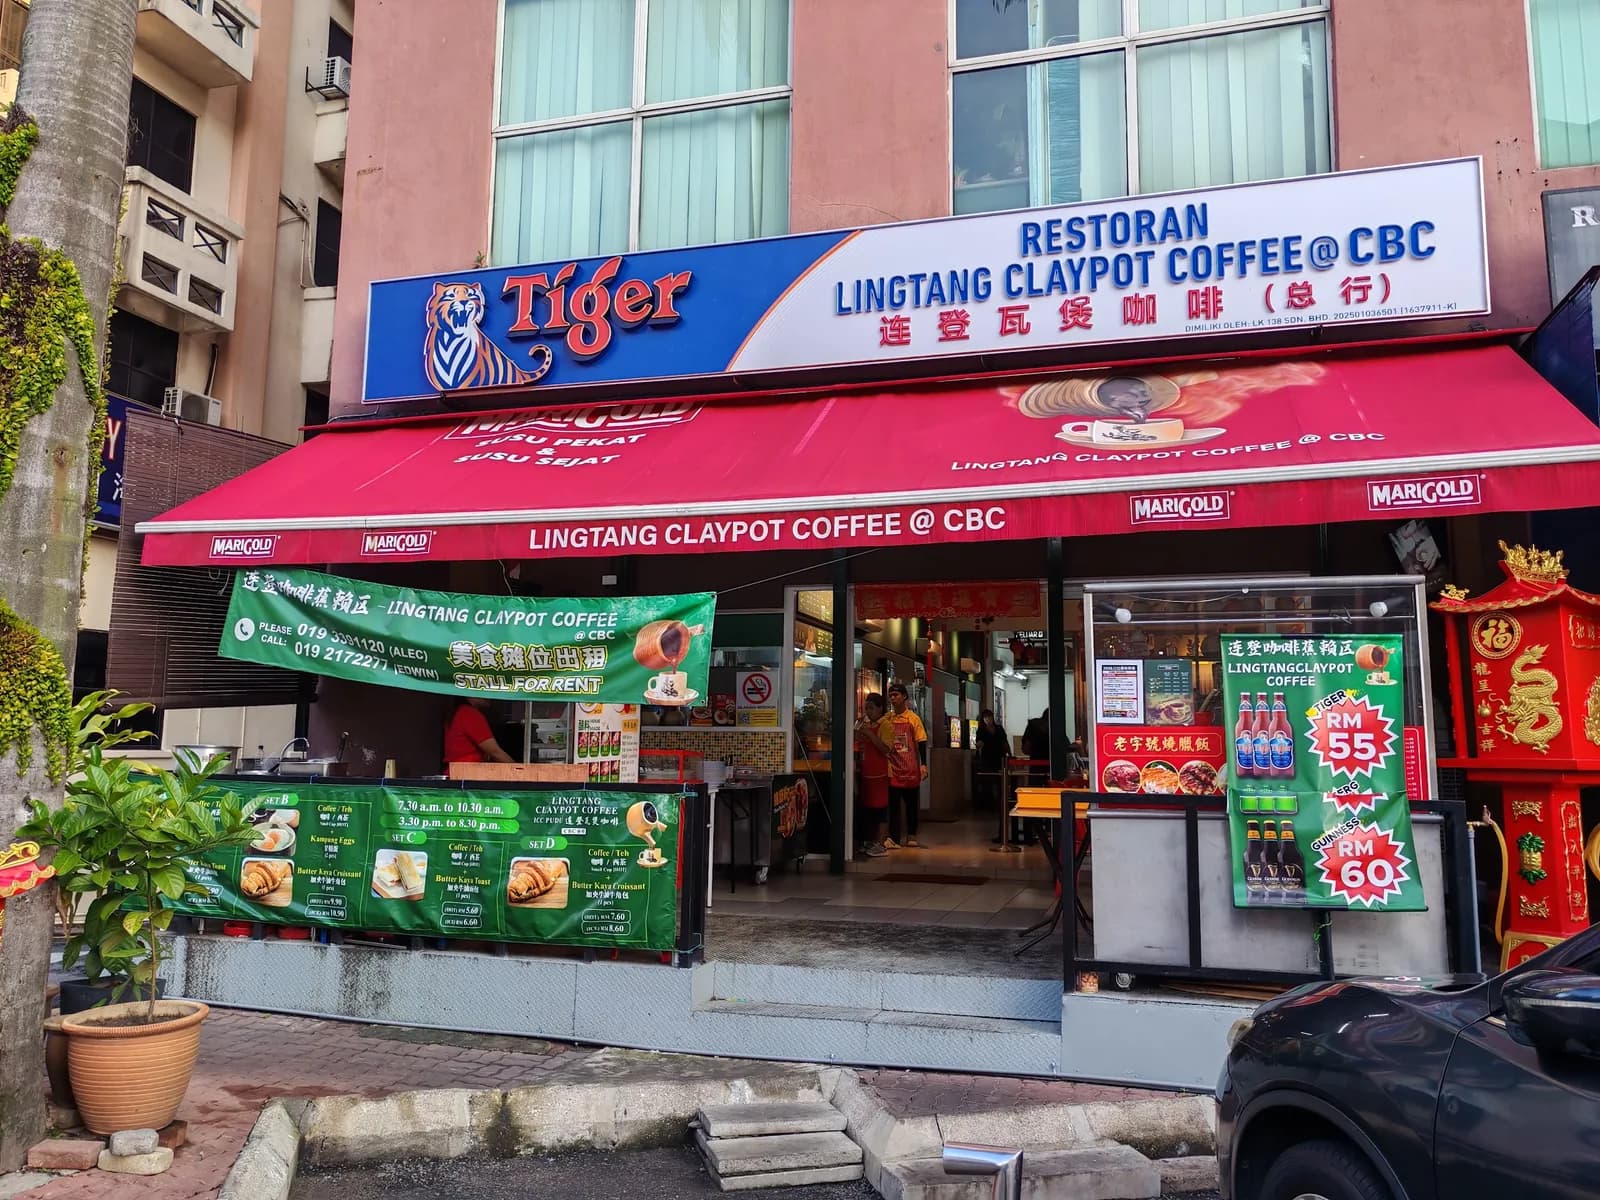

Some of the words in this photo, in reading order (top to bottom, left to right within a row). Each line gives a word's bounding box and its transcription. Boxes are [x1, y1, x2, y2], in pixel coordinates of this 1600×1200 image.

[1021, 202, 1209, 257] RESTORAN
[835, 267, 992, 315] LINGTANG
[1004, 251, 1155, 298] CLAYPOT
[502, 256, 693, 357] Tiger
[1185, 323, 1222, 333] DIMILIKI
[1252, 319, 1264, 327] LK
[1267, 317, 1282, 325] 138
[1284, 316, 1305, 324] SDN.
[1308, 314, 1331, 322] BHD.
[1333, 309, 1397, 320] 202501036501
[475, 433, 547, 447] SUSU
[553, 434, 647, 447] PEKAT
[453, 452, 530, 464] SUSU
[535, 454, 621, 467] SEJAT
[536, 447, 557, 456] &
[951, 451, 1069, 471] LINGTANG
[1075, 450, 1185, 463] CLAYPOT
[1191, 440, 1291, 457] COFFEE
[1298, 433, 1321, 445] @
[1330, 432, 1386, 441] CBC
[1372, 480, 1474, 506] MARIGOLD
[1135, 495, 1224, 520] MARIGOLD
[529, 524, 657, 549] LINGTANG
[664, 519, 785, 545] CLAYPOT
[792, 512, 902, 541] COFFEE
[909, 509, 935, 535] @
[944, 506, 1007, 532] CBC
[213, 537, 273, 556] MARIGOLD
[364, 534, 428, 553] MARIGOLD
[475, 610, 547, 627] CLAYPOT
[552, 612, 618, 628] COFFEE
[259, 622, 292, 635] PLEASE
[574, 631, 586, 641] @
[589, 630, 615, 640] CBC
[1480, 619, 1513, 649] 福
[261, 634, 287, 646] CALL:
[298, 623, 328, 640] 019
[331, 630, 385, 653] 3391120
[389, 646, 428, 663] (ALEC)
[295, 642, 320, 658] 019
[324, 647, 388, 671] 2172277
[394, 664, 440, 681] (EDWIN)
[455, 674, 510, 692] STALL
[513, 677, 549, 692] FOR
[552, 677, 602, 693] RENT
[1266, 676, 1316, 687] COFFEE
[1314, 690, 1346, 716] TIGER
[1327, 713, 1362, 729] RM
[1328, 732, 1376, 760] 55
[398, 800, 418, 811] 7.30
[420, 803, 442, 812] a.m.
[444, 803, 454, 812] to
[458, 802, 482, 813] 10.30
[484, 806, 504, 815] a.m.
[552, 796, 602, 806] LINGTANG
[535, 805, 579, 814] CLAYPOT
[582, 806, 618, 815] COFFEE
[398, 816, 420, 826] 3.30
[422, 820, 443, 829] p.m.
[446, 819, 456, 827] to
[458, 818, 477, 828] 8.30
[479, 821, 501, 831] p.m.
[339, 837, 355, 846] Eggs
[392, 834, 405, 843] SET
[406, 832, 416, 842] C
[1312, 817, 1360, 851] GUINNESS
[529, 839, 545, 849] SET
[546, 838, 555, 849] D
[1338, 839, 1374, 856] RM
[588, 848, 610, 857] Coffee
[1341, 859, 1394, 888] 60
[613, 881, 645, 890] Croissant
[610, 912, 625, 921] 7.60
